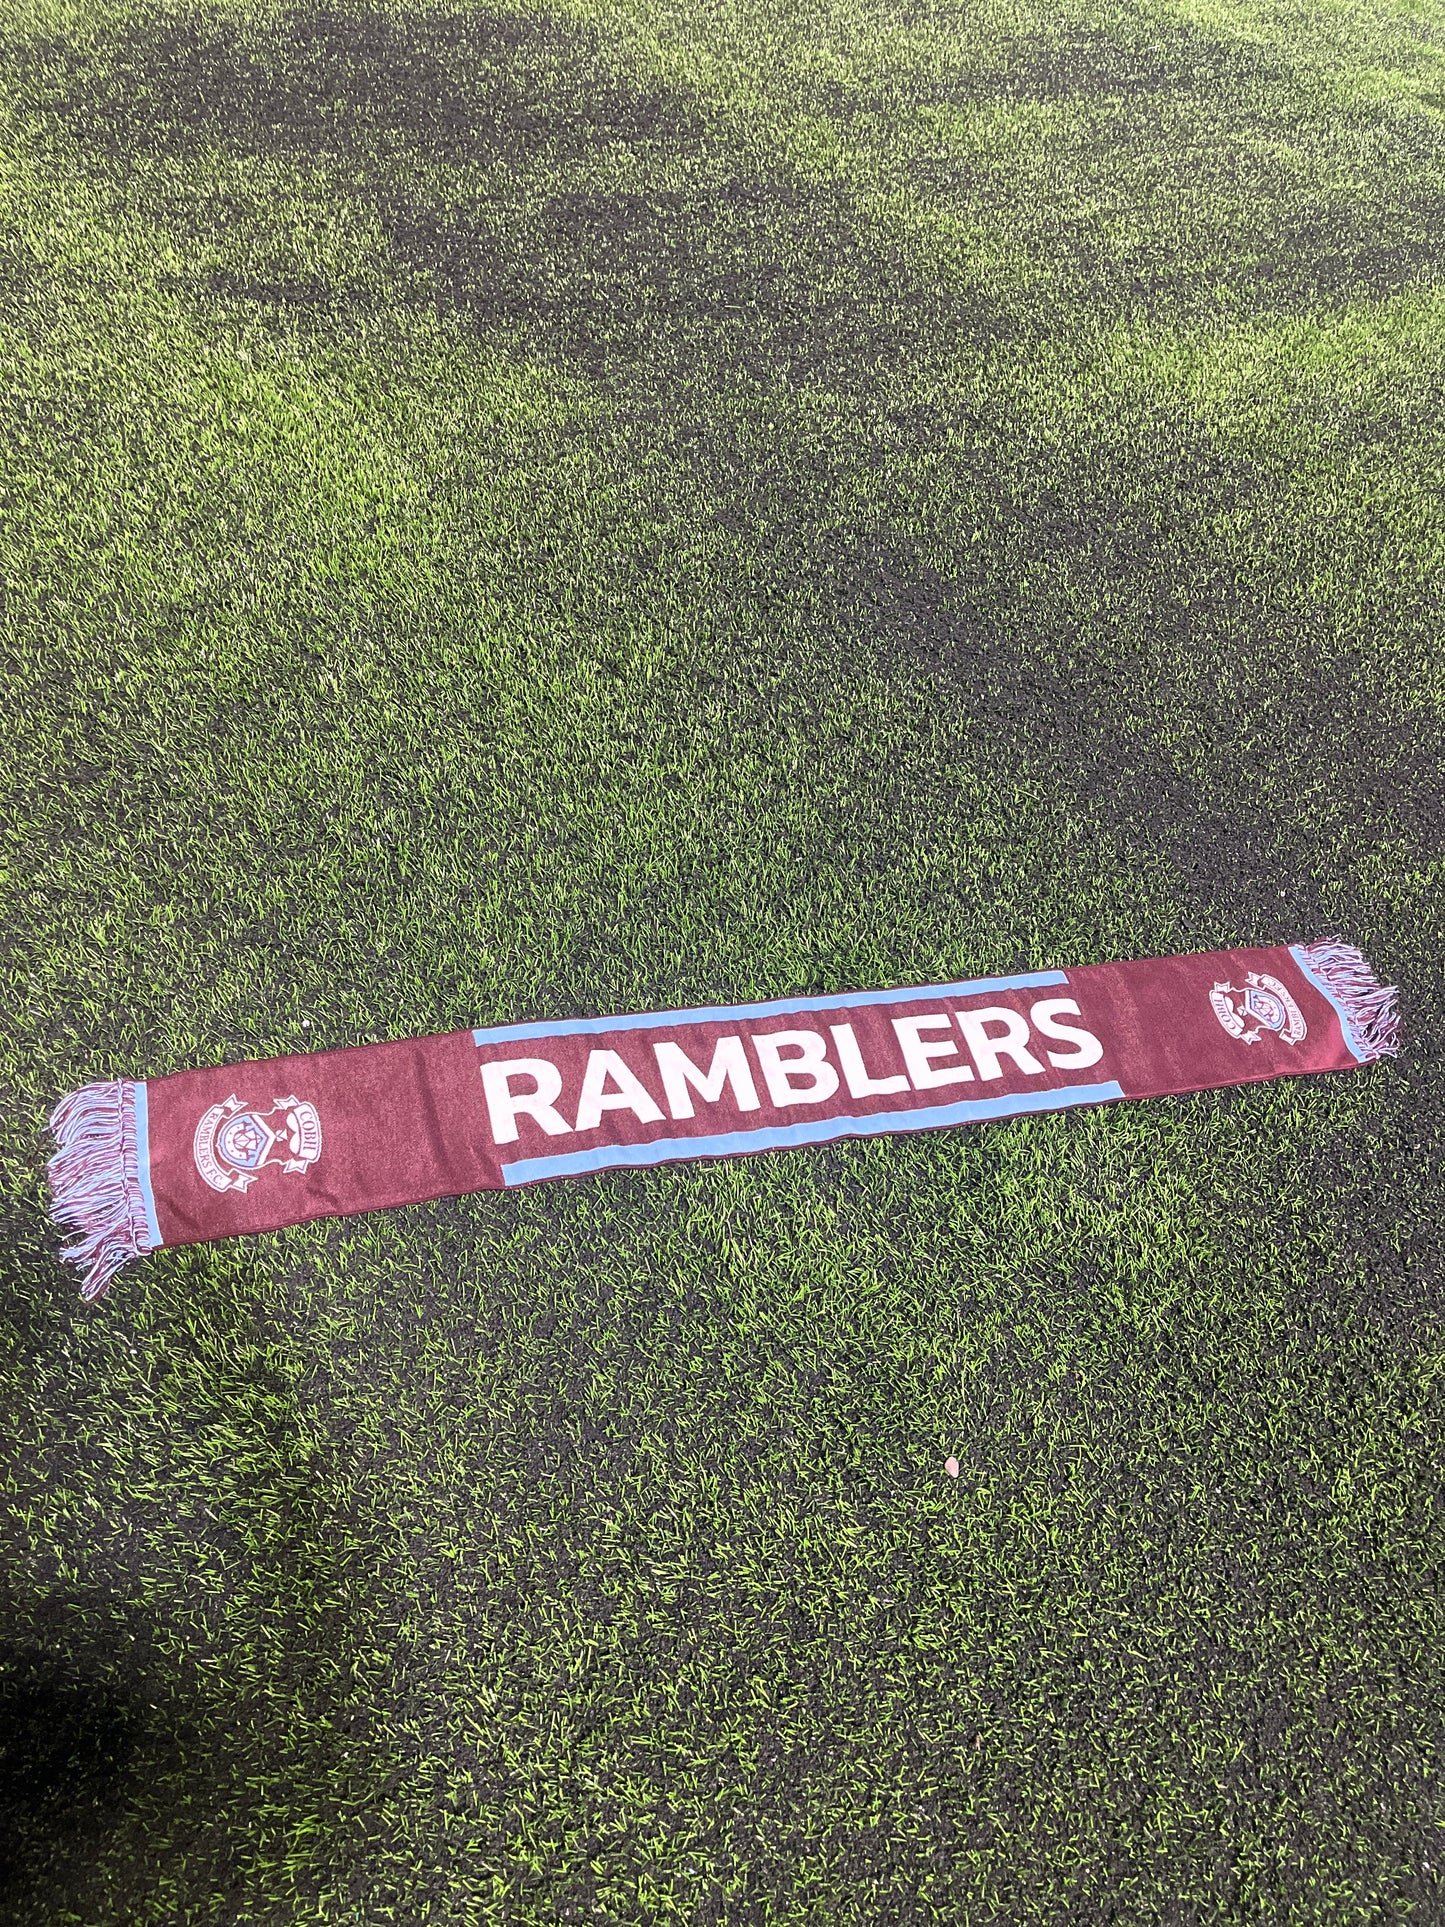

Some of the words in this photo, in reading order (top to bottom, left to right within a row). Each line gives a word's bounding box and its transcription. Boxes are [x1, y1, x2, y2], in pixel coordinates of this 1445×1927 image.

[479, 998, 1104, 1144] RAMBLERS
[198, 1112, 219, 1168] RAMBLERS
[300, 1110, 317, 1150] COBH
